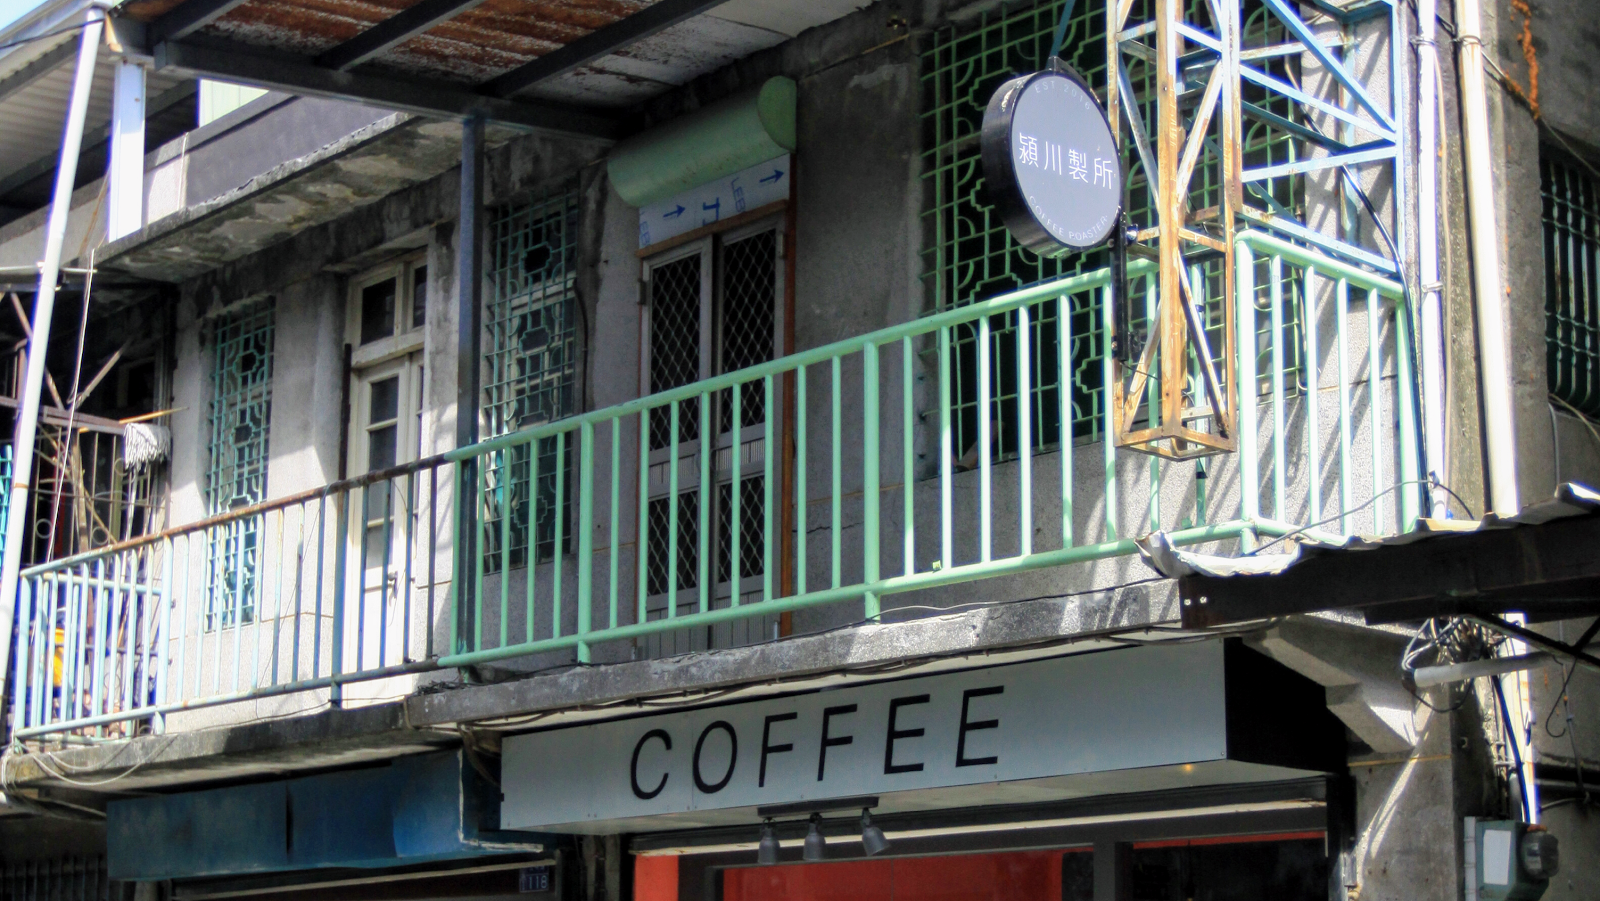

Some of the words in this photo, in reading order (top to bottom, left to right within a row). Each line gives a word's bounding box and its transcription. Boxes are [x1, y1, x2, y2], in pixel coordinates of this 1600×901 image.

[1063, 83, 1091, 110] 2016
[1029, 195, 1064, 237] COFFEE
[630, 685, 1005, 801] COFFEE
[528, 875, 549, 889] 118
